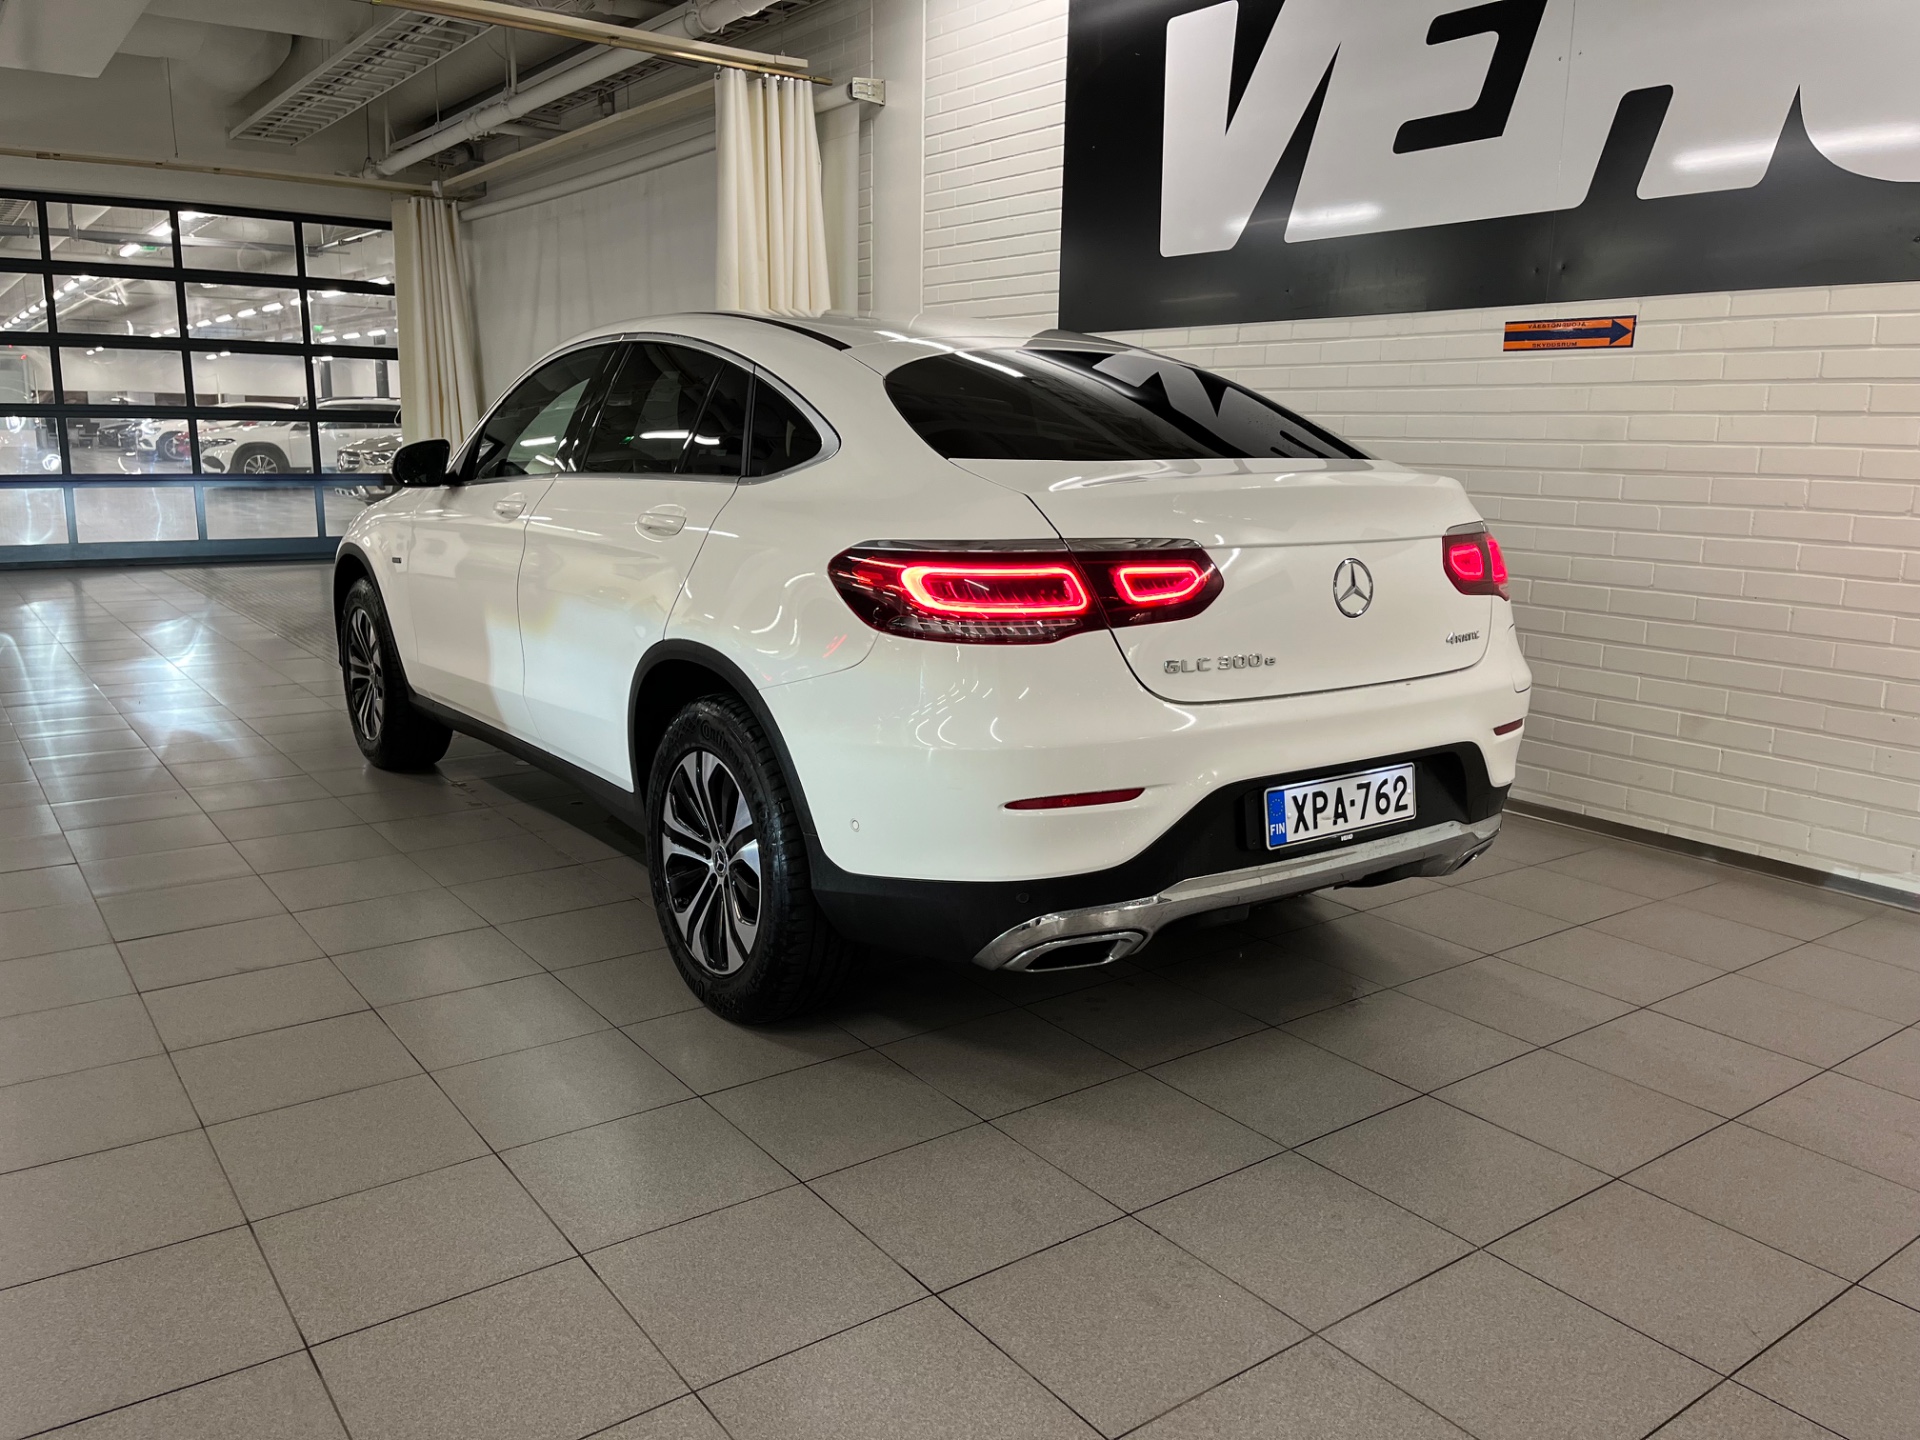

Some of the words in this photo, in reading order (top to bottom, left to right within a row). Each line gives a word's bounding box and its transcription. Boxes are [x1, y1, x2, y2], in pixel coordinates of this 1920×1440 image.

[1160, 0, 1920, 257] VEH
[1164, 658, 1211, 674] GLC
[1291, 775, 1409, 834] XPA-762
[1270, 822, 1286, 836] FIN
